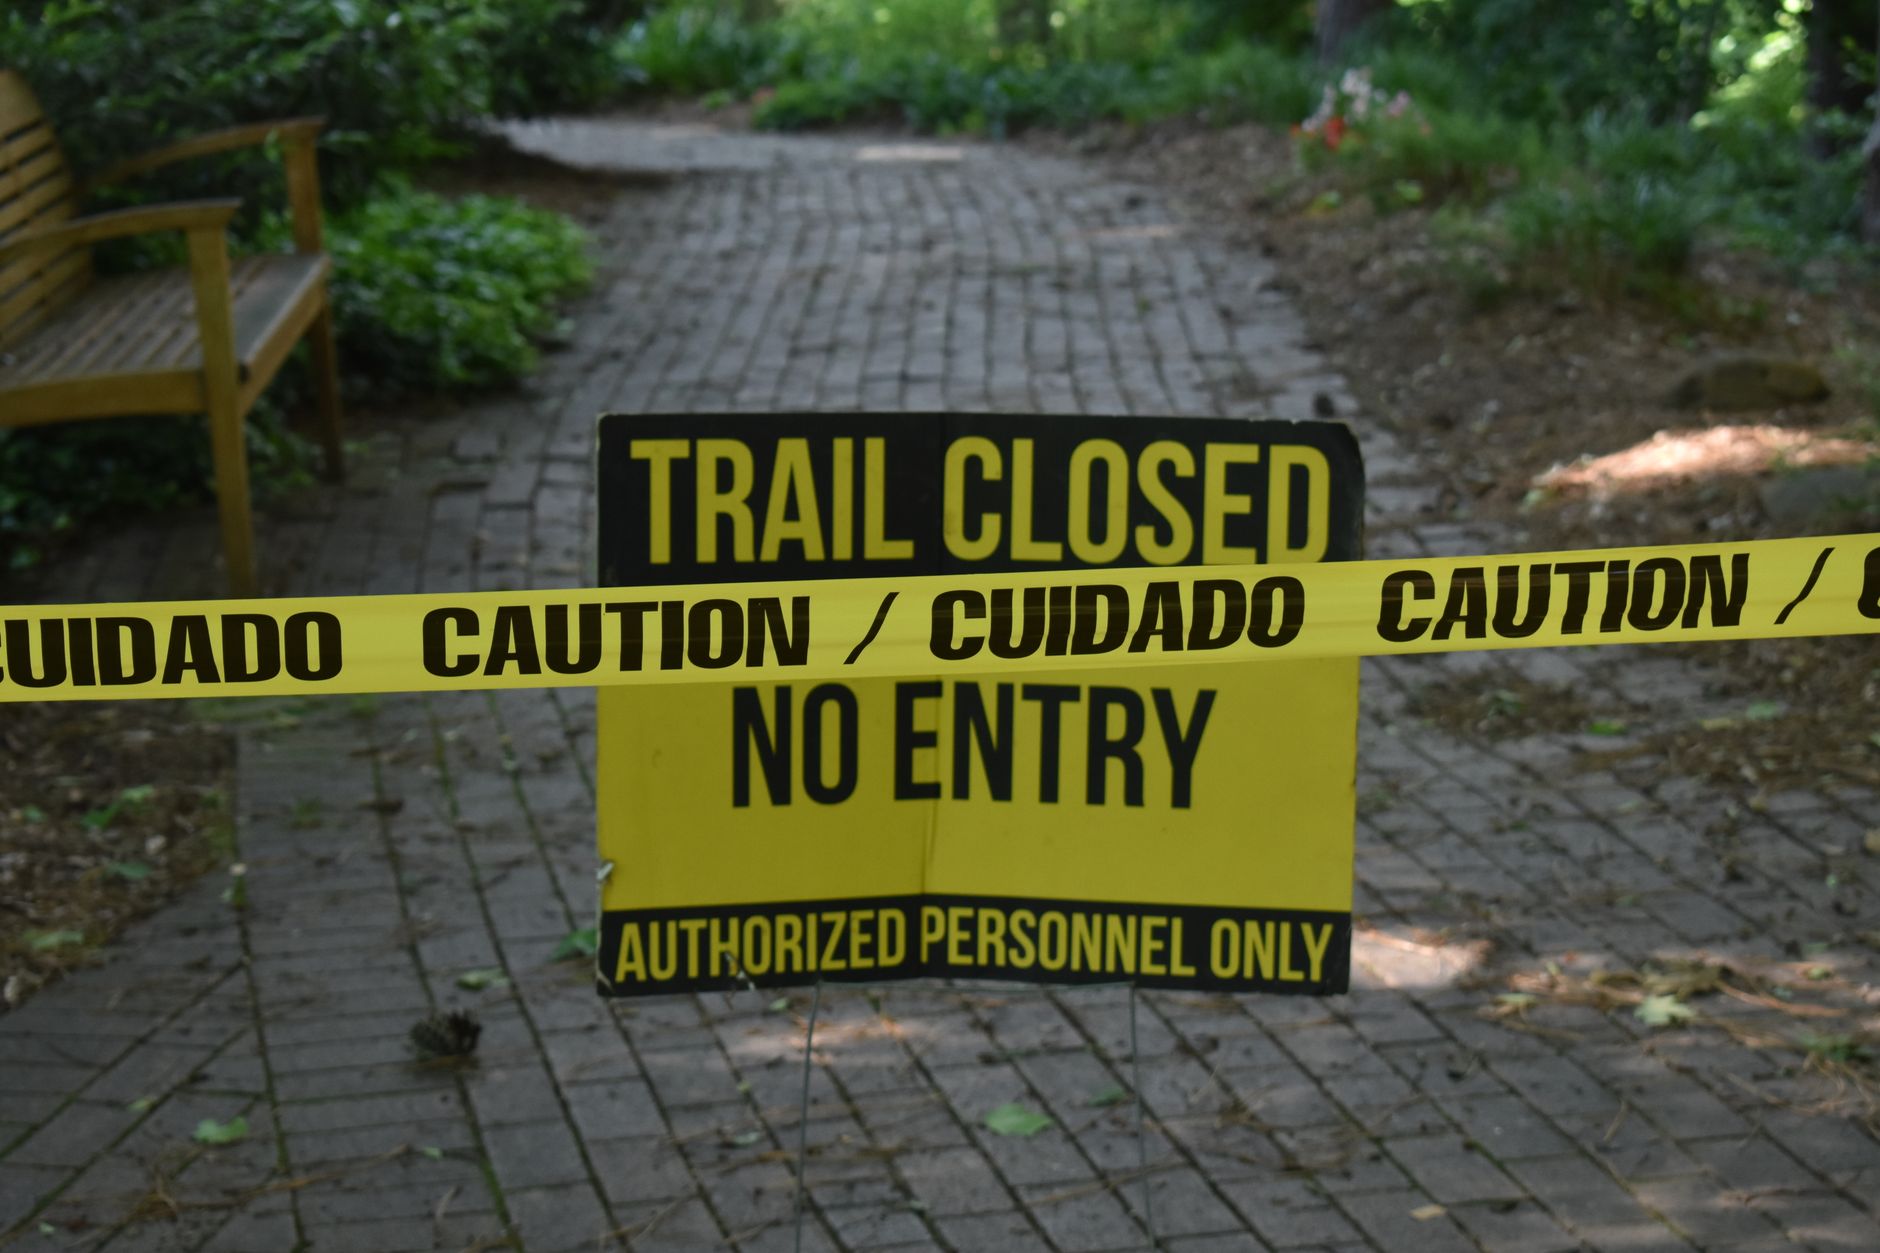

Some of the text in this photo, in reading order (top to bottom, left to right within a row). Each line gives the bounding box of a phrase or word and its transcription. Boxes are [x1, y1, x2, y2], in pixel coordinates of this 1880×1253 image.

[630, 436, 1330, 566] TRAIL CLOSED
[0, 611, 342, 688] UIDADO
[423, 596, 810, 677] CAUTION
[843, 591, 900, 665] /
[930, 576, 1305, 660] CUIDADO
[1377, 553, 1750, 642] CAUTION
[1774, 547, 1835, 624] /
[732, 681, 1217, 809] NO ENTRY
[615, 906, 1333, 983] AUTHORIZED PERSONNEL ONLY
